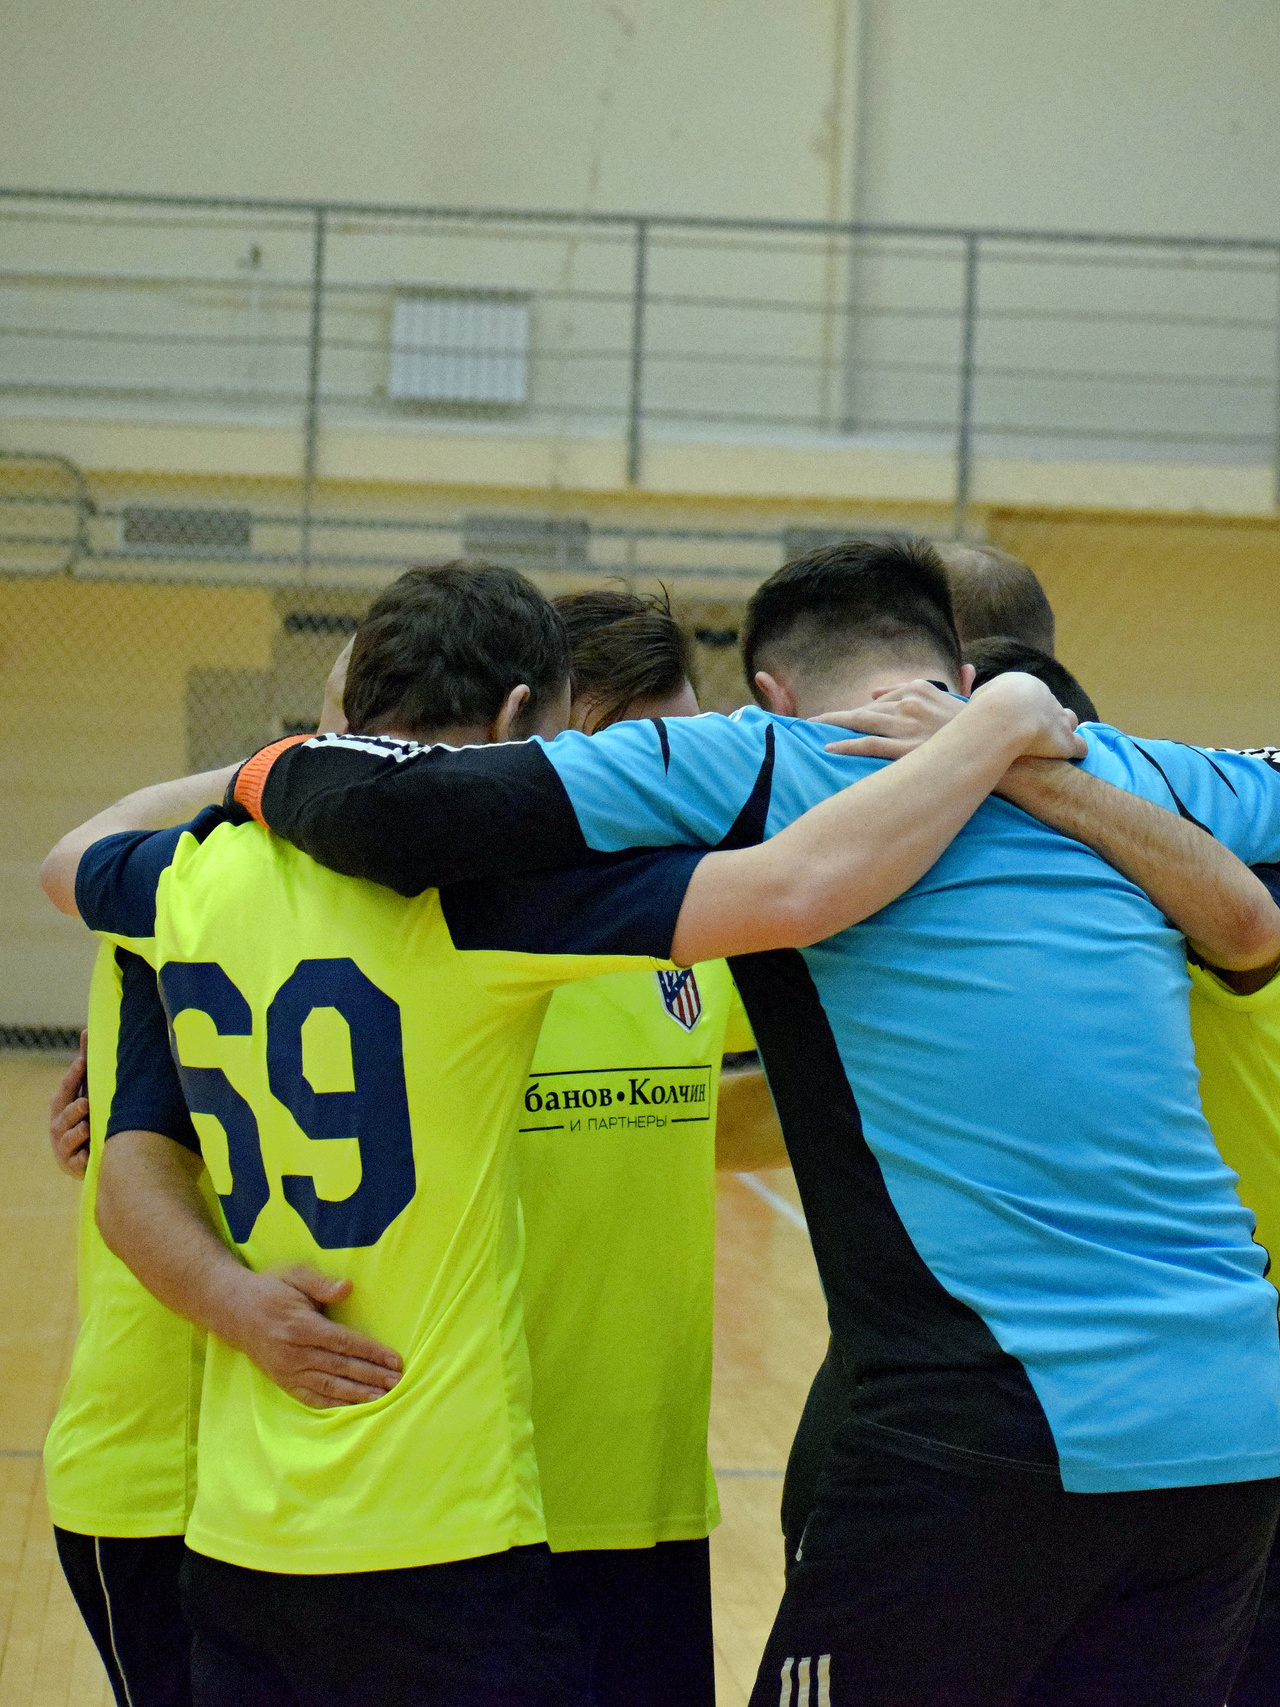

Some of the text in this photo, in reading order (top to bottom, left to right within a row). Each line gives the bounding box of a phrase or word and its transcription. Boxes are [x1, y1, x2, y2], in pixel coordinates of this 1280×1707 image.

[158, 957, 416, 1250] 69
[570, 1115, 667, 1132] И ПАРТНЕРЫ
